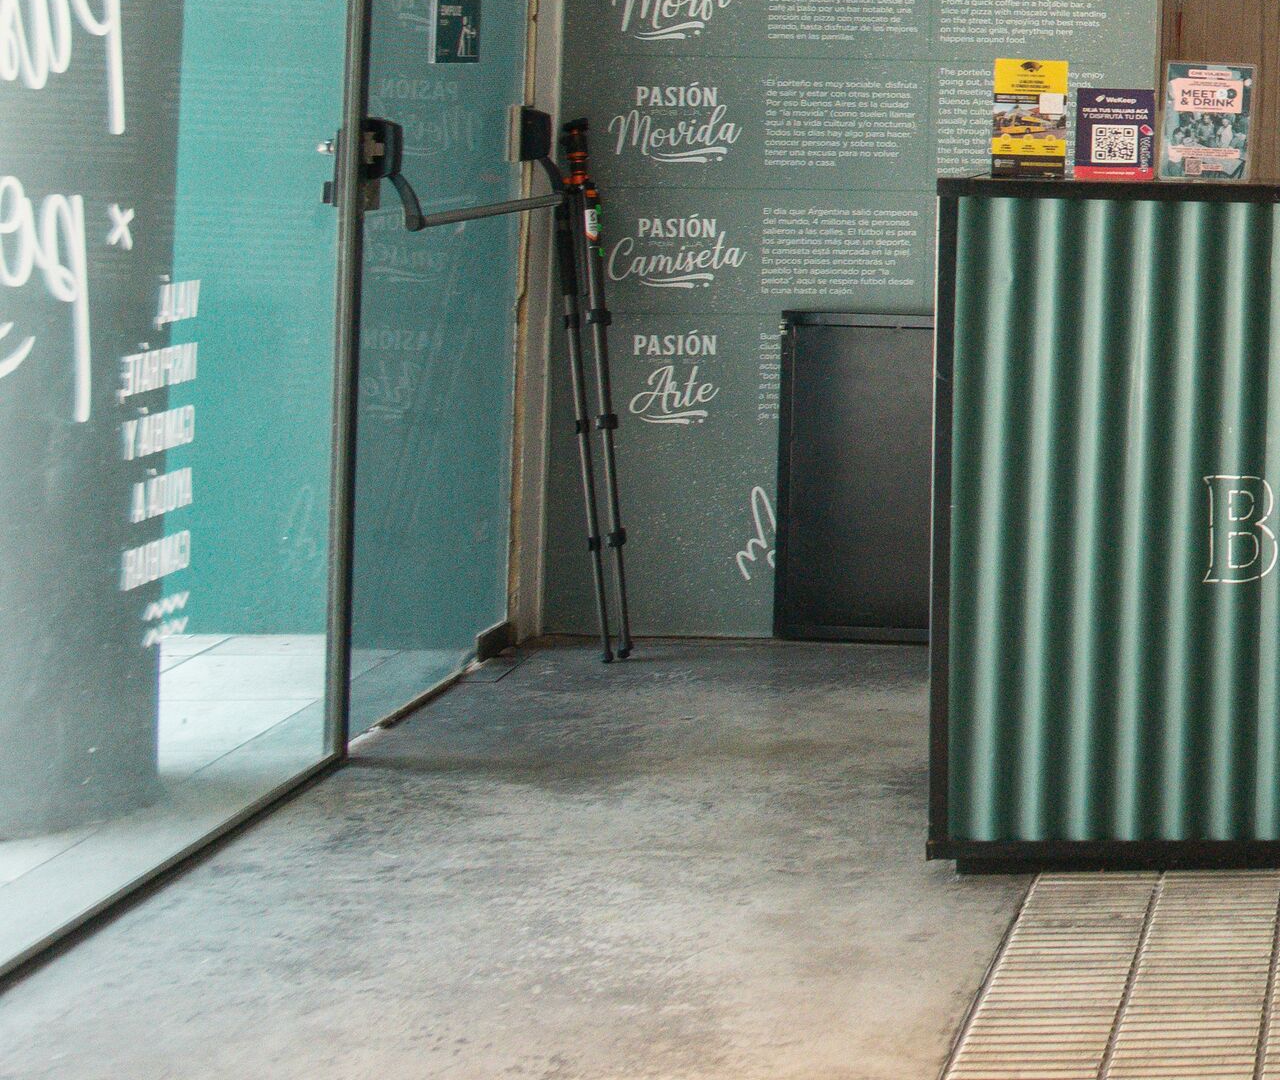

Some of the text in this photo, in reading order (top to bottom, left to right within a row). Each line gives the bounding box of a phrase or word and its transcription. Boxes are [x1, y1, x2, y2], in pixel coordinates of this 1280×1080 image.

[635, 81, 718, 107] PASIÓN
[1105, 96, 1137, 105] WeKeep
[1180, 98, 1235, 107] & DRINK
[1181, 89, 1217, 98] MEET
[607, 104, 743, 156] Movida
[637, 213, 717, 238] PASIÓN
[607, 231, 748, 281] Camiseta
[633, 329, 718, 356] PASIÓN
[628, 365, 720, 414] Arte
